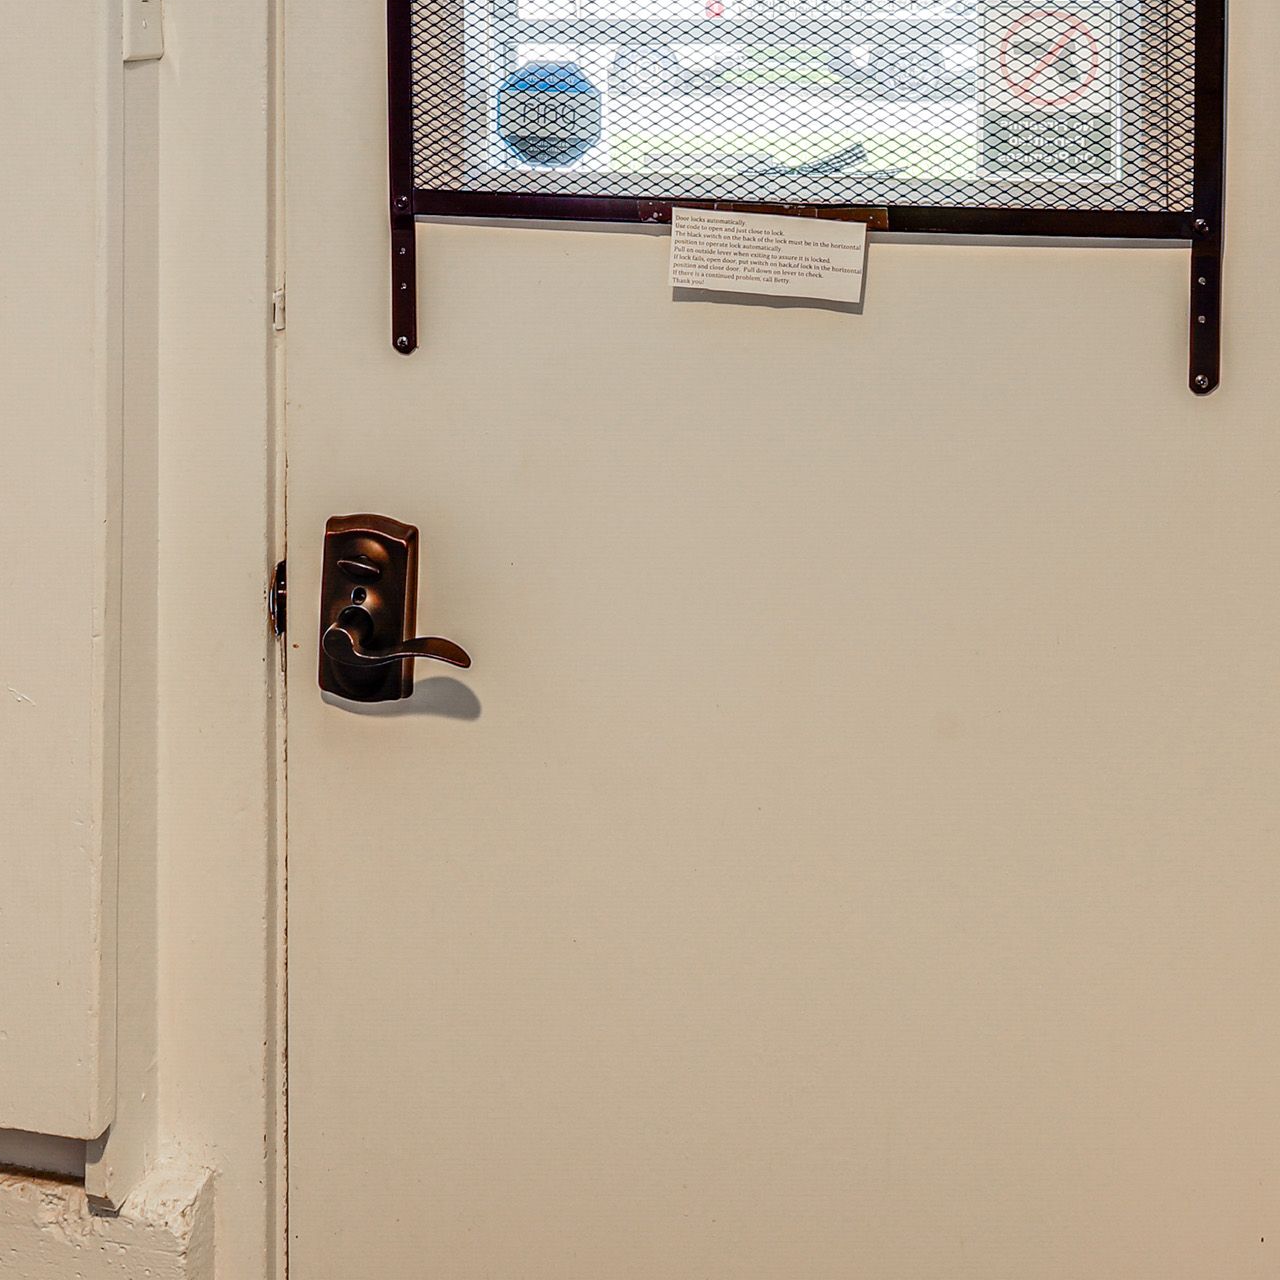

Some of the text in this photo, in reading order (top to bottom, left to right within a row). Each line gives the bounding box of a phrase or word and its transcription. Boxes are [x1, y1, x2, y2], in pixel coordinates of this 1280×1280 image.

[523, 97, 576, 132] ring
[831, 242, 861, 250] horizontal
[832, 266, 862, 274] horizontal
